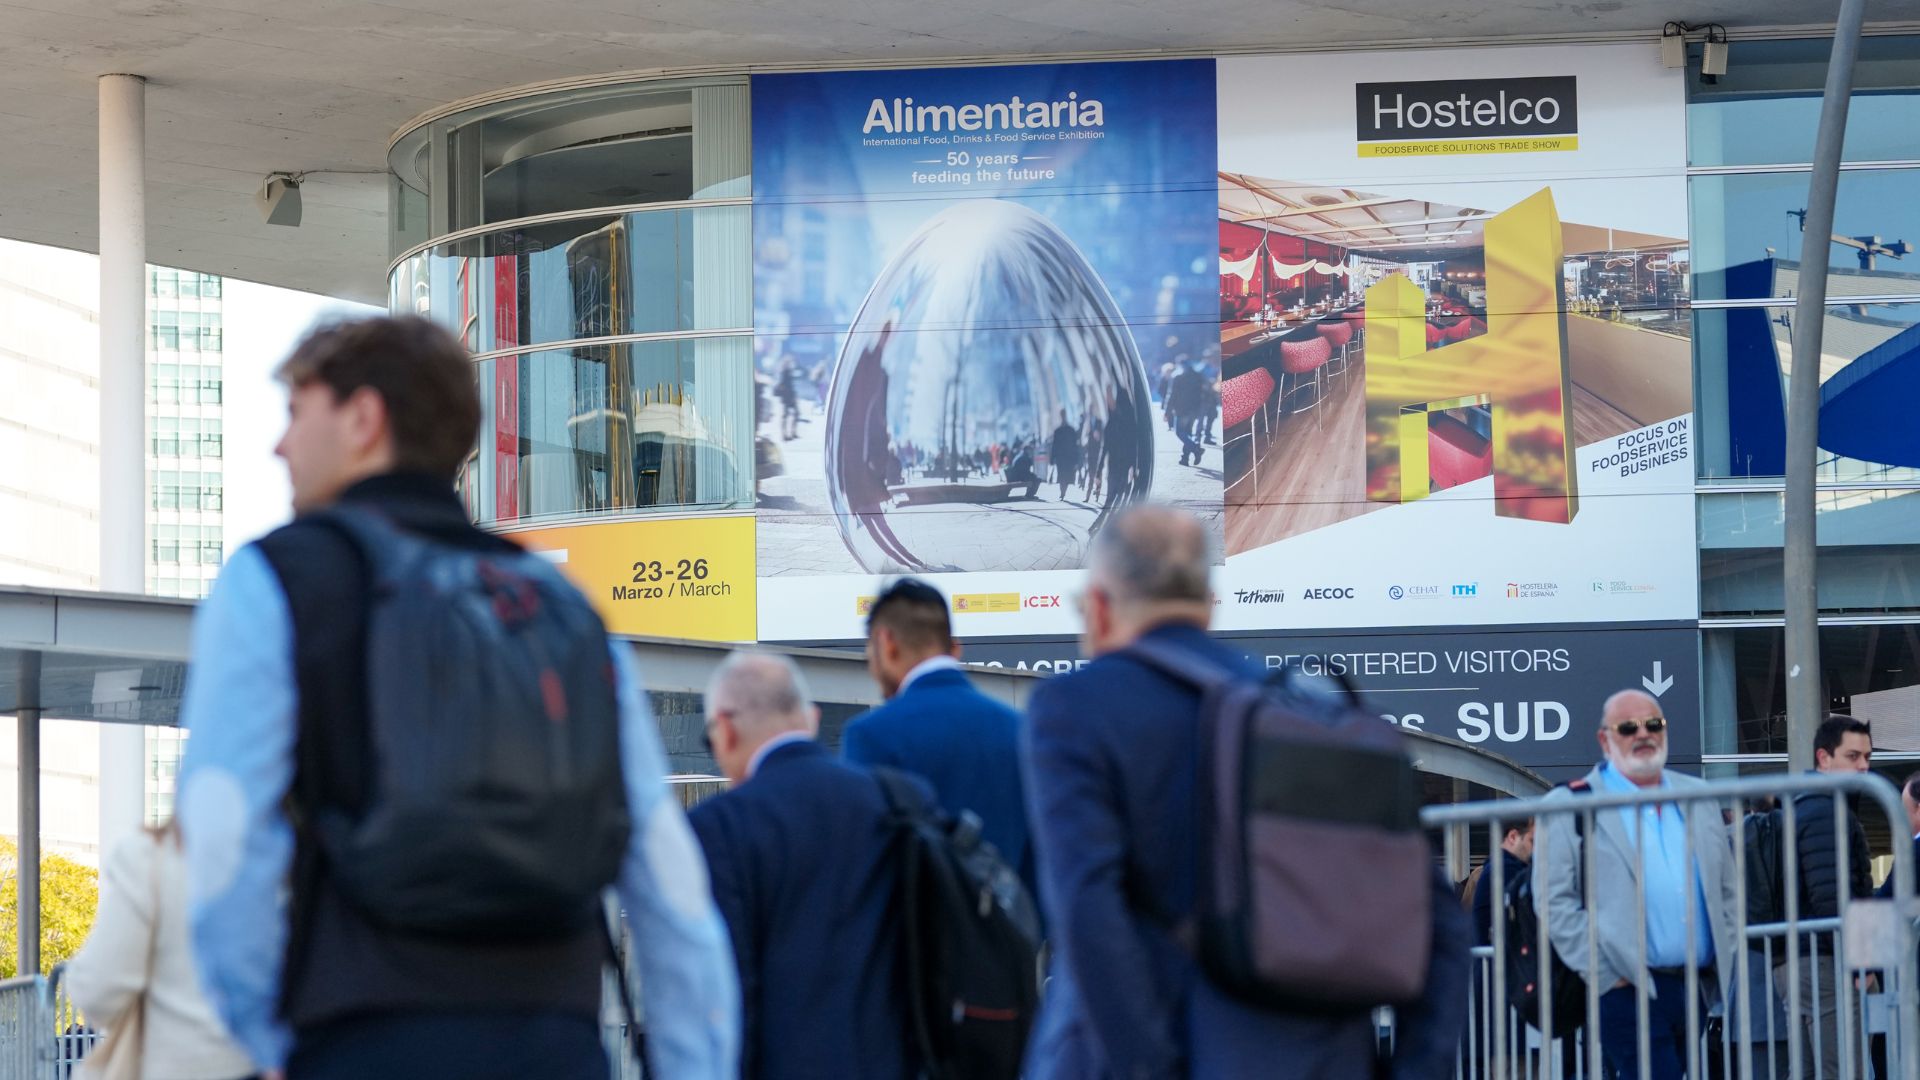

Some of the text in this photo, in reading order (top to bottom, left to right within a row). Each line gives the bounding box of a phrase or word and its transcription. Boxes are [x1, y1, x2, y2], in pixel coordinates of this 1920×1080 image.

[863, 91, 1105, 134] Alimentaria
[1374, 90, 1560, 129] Hostelco
[863, 130, 1105, 146] International Food, Drinks & Food Service Exhibition
[1375, 141, 1561, 154] FOODSERVICE SOLUTIONS TRADE SHOW
[946, 151, 1019, 168] 50 years
[912, 168, 1055, 185] feeding the future
[1618, 419, 1687, 450] FOCUS ON
[1592, 433, 1688, 472] FOODSERVICE
[1621, 447, 1688, 477] BUSINESS
[632, 558, 709, 583] 23-26
[612, 581, 731, 600] Marzo / March
[1303, 588, 1355, 600] AECOC
[1452, 585, 1476, 595] ITH
[1265, 649, 1571, 677] REGISTERED VISITORS
[1456, 701, 1571, 743] SUD
